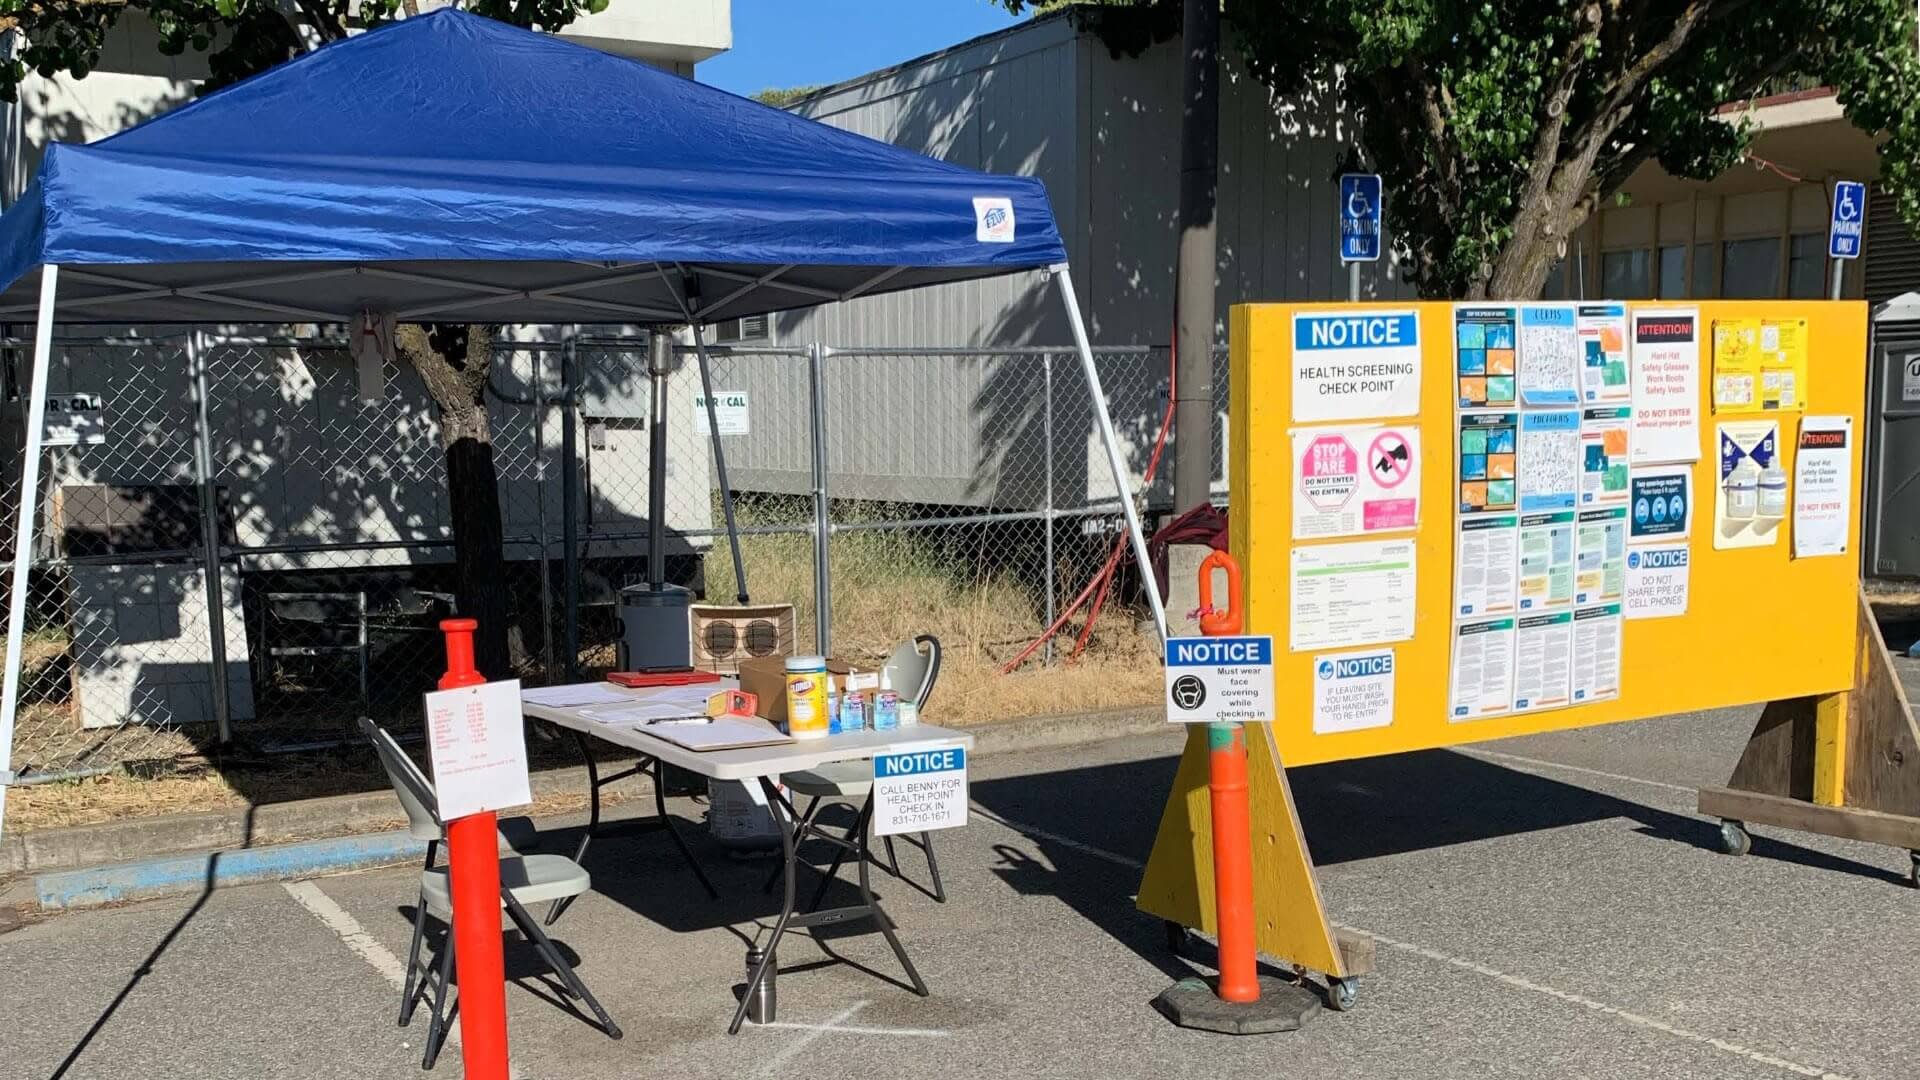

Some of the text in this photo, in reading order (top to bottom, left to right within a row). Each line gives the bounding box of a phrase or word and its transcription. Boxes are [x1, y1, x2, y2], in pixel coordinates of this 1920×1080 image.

[1343, 219, 1377, 235] PARKING
[1834, 220, 1860, 236] PARKING
[1350, 238, 1369, 254] ONLY
[1837, 238, 1853, 252] ONLY
[1312, 319, 1400, 346] NOTICE
[1638, 324, 1692, 336] ATTENTION!
[1651, 352, 1667, 360] Hard
[1300, 363, 1413, 379] HEALTH SCREENING
[1641, 362, 1689, 372] Safety Glasses
[1319, 381, 1395, 395] CHECK POINT
[1646, 385, 1685, 395] Safety Vests
[71, 398, 98, 411] CAL
[696, 397, 745, 408] NR CAL
[1638, 408, 1691, 418] DO NOT ENTER
[1313, 443, 1346, 457] STOP
[1314, 460, 1346, 476] PARE
[1643, 550, 1687, 568] NOTICE
[1642, 575, 1672, 585] DO NOT
[1627, 584, 1684, 598] SHARE PPE OR
[1629, 596, 1682, 609] CELL PHONES
[1178, 643, 1260, 662] NOTICE
[1337, 656, 1392, 677] NOTICE
[1221, 689, 1259, 697] covering
[1336, 684, 1366, 695] LEAVING
[1368, 682, 1382, 691] SITE
[1326, 691, 1384, 704] YOU MUST WASH
[1320, 698, 1389, 713] YOUR HANDS PRIOR
[1216, 710, 1255, 719] checking
[1332, 709, 1378, 720] TO RE-ENTRY
[886, 752, 954, 774] NOTICE
[880, 779, 960, 795] CALL BENNY FOR
[888, 789, 954, 804] HEALTH POINT
[899, 801, 944, 814] CHECK IN
[892, 811, 950, 825] 831-710-1671
